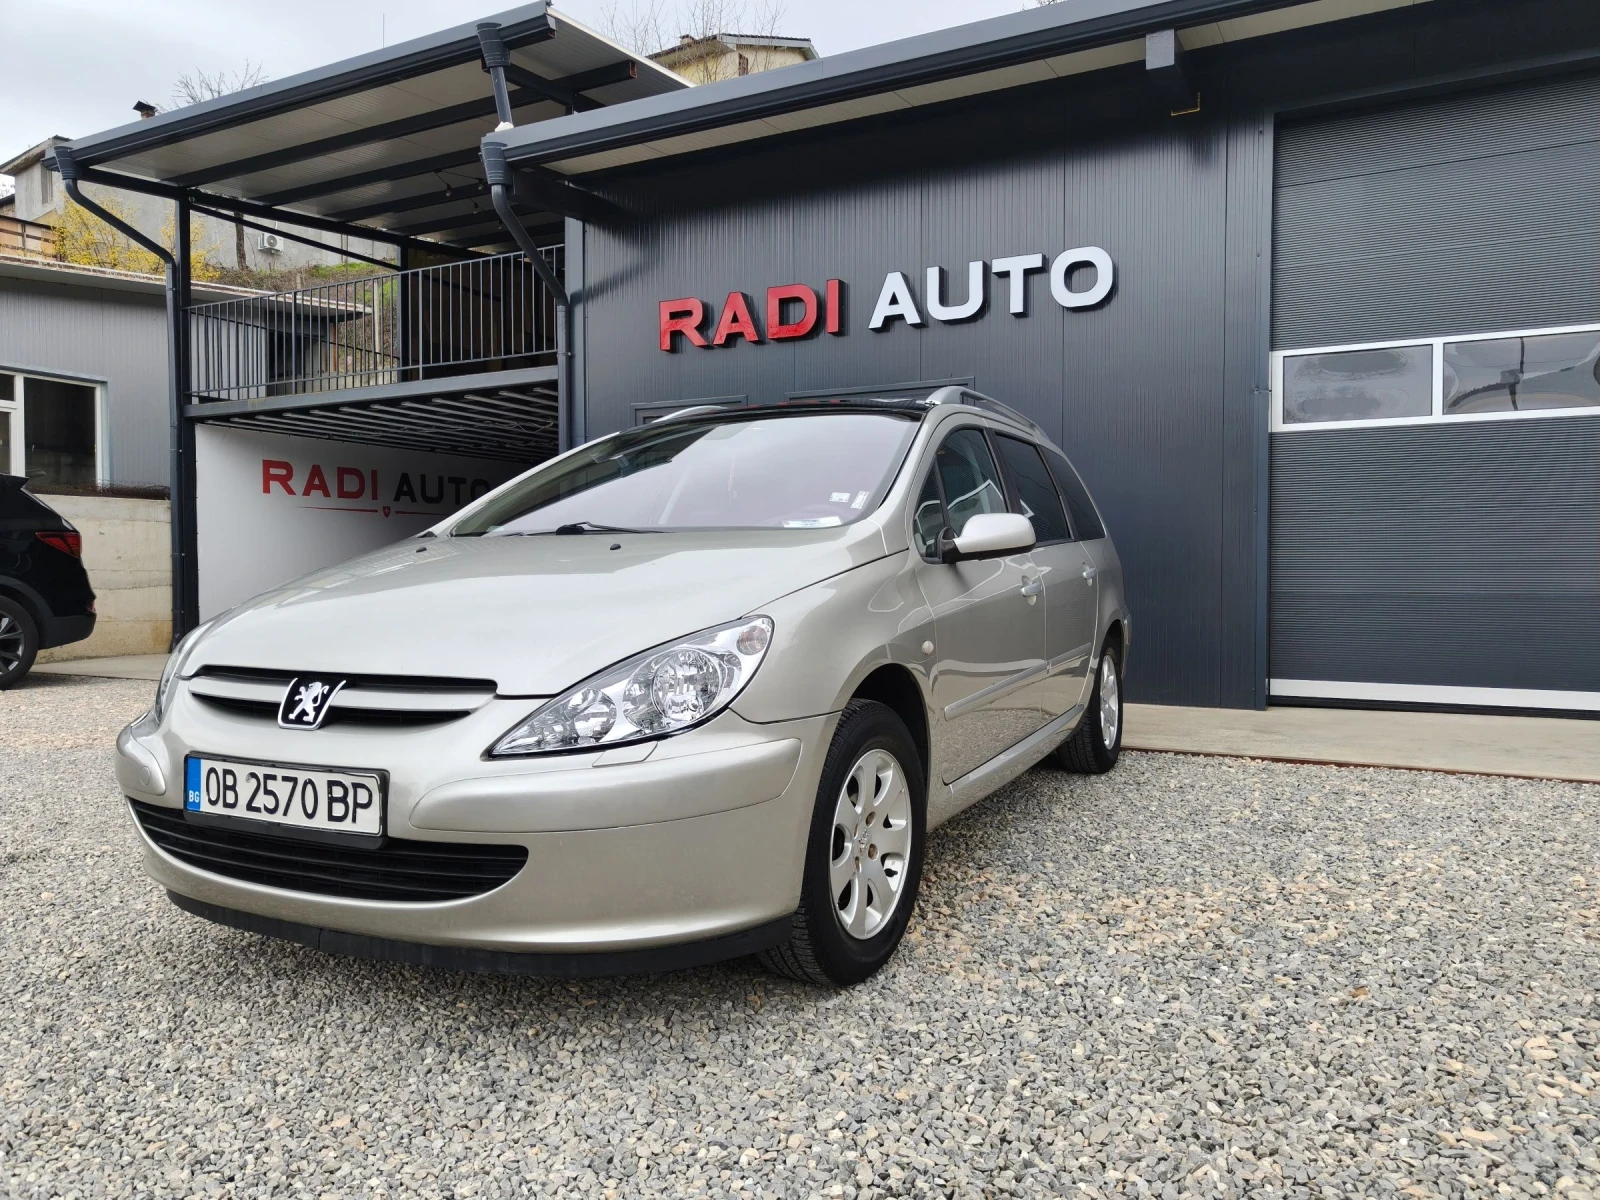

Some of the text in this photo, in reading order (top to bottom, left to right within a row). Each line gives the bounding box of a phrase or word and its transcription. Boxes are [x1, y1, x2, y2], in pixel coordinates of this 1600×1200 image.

[659, 245, 1115, 351] RADI AUTO
[262, 459, 491, 505] RADI AUTO
[188, 790, 200, 803] BG
[205, 766, 373, 824] OB 2570 BP
